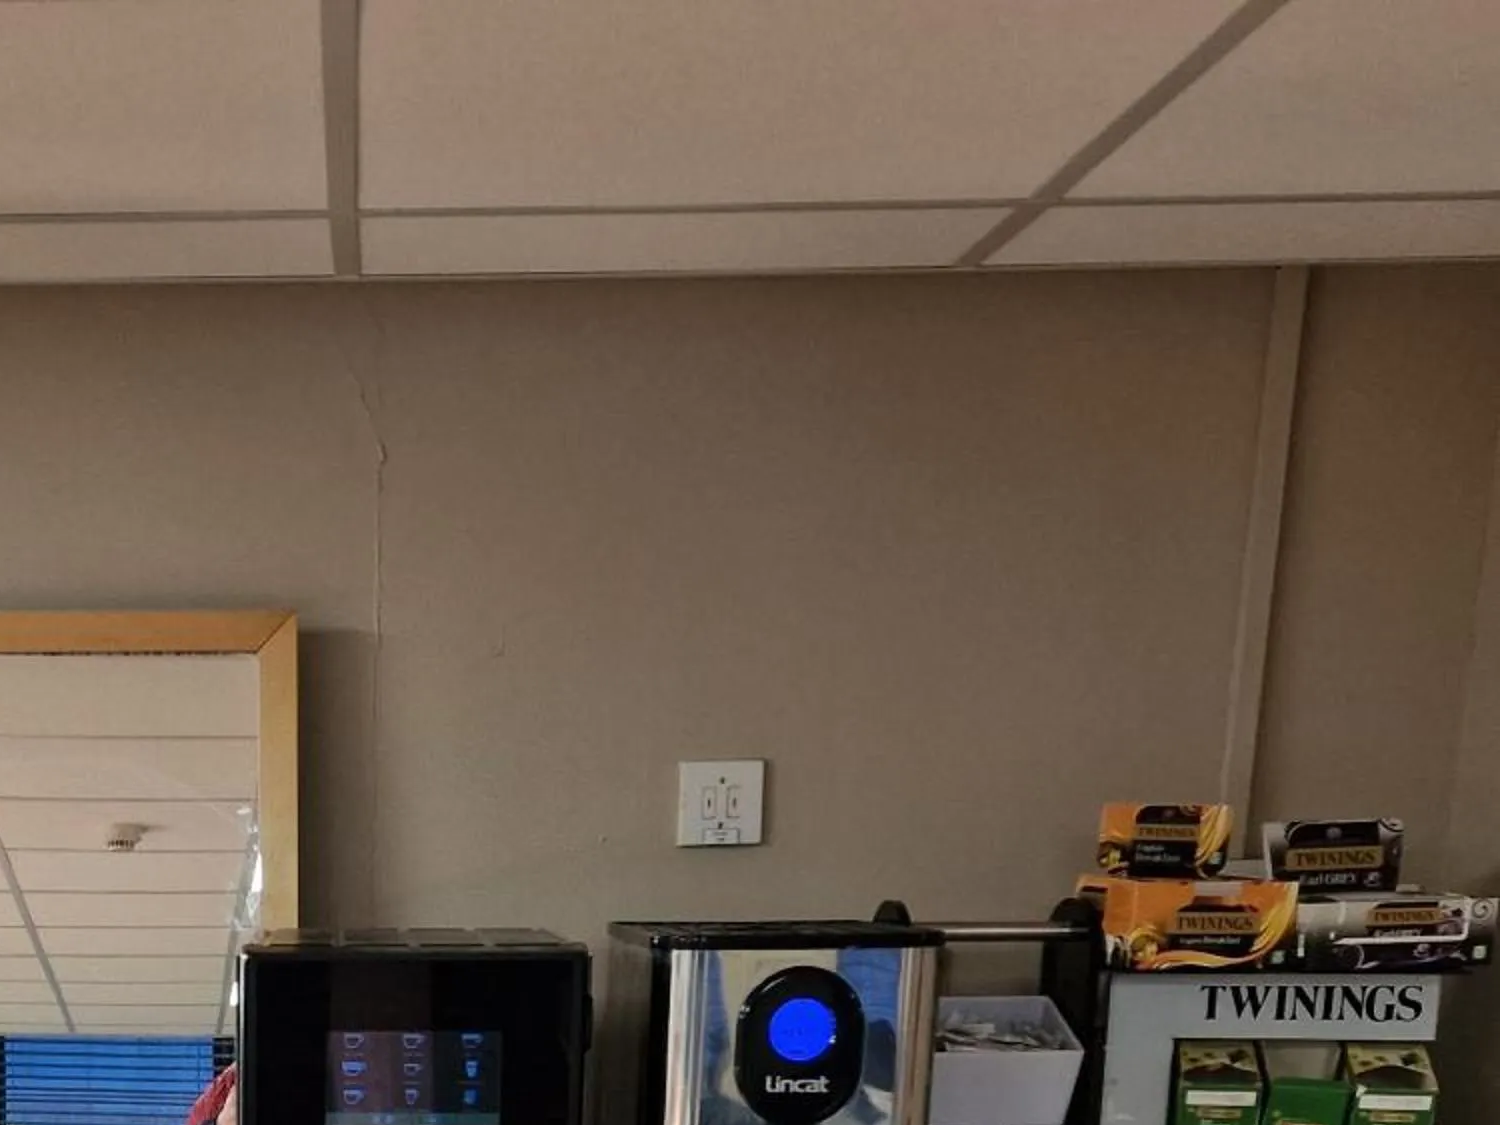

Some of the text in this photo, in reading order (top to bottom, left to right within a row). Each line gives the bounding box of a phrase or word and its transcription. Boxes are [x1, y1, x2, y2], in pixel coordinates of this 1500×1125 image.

[1295, 848, 1377, 866] TWININGS
[1176, 914, 1255, 931] TWININGS
[1374, 910, 1438, 922] TWININGS
[1200, 984, 1424, 1023] TWININGS
